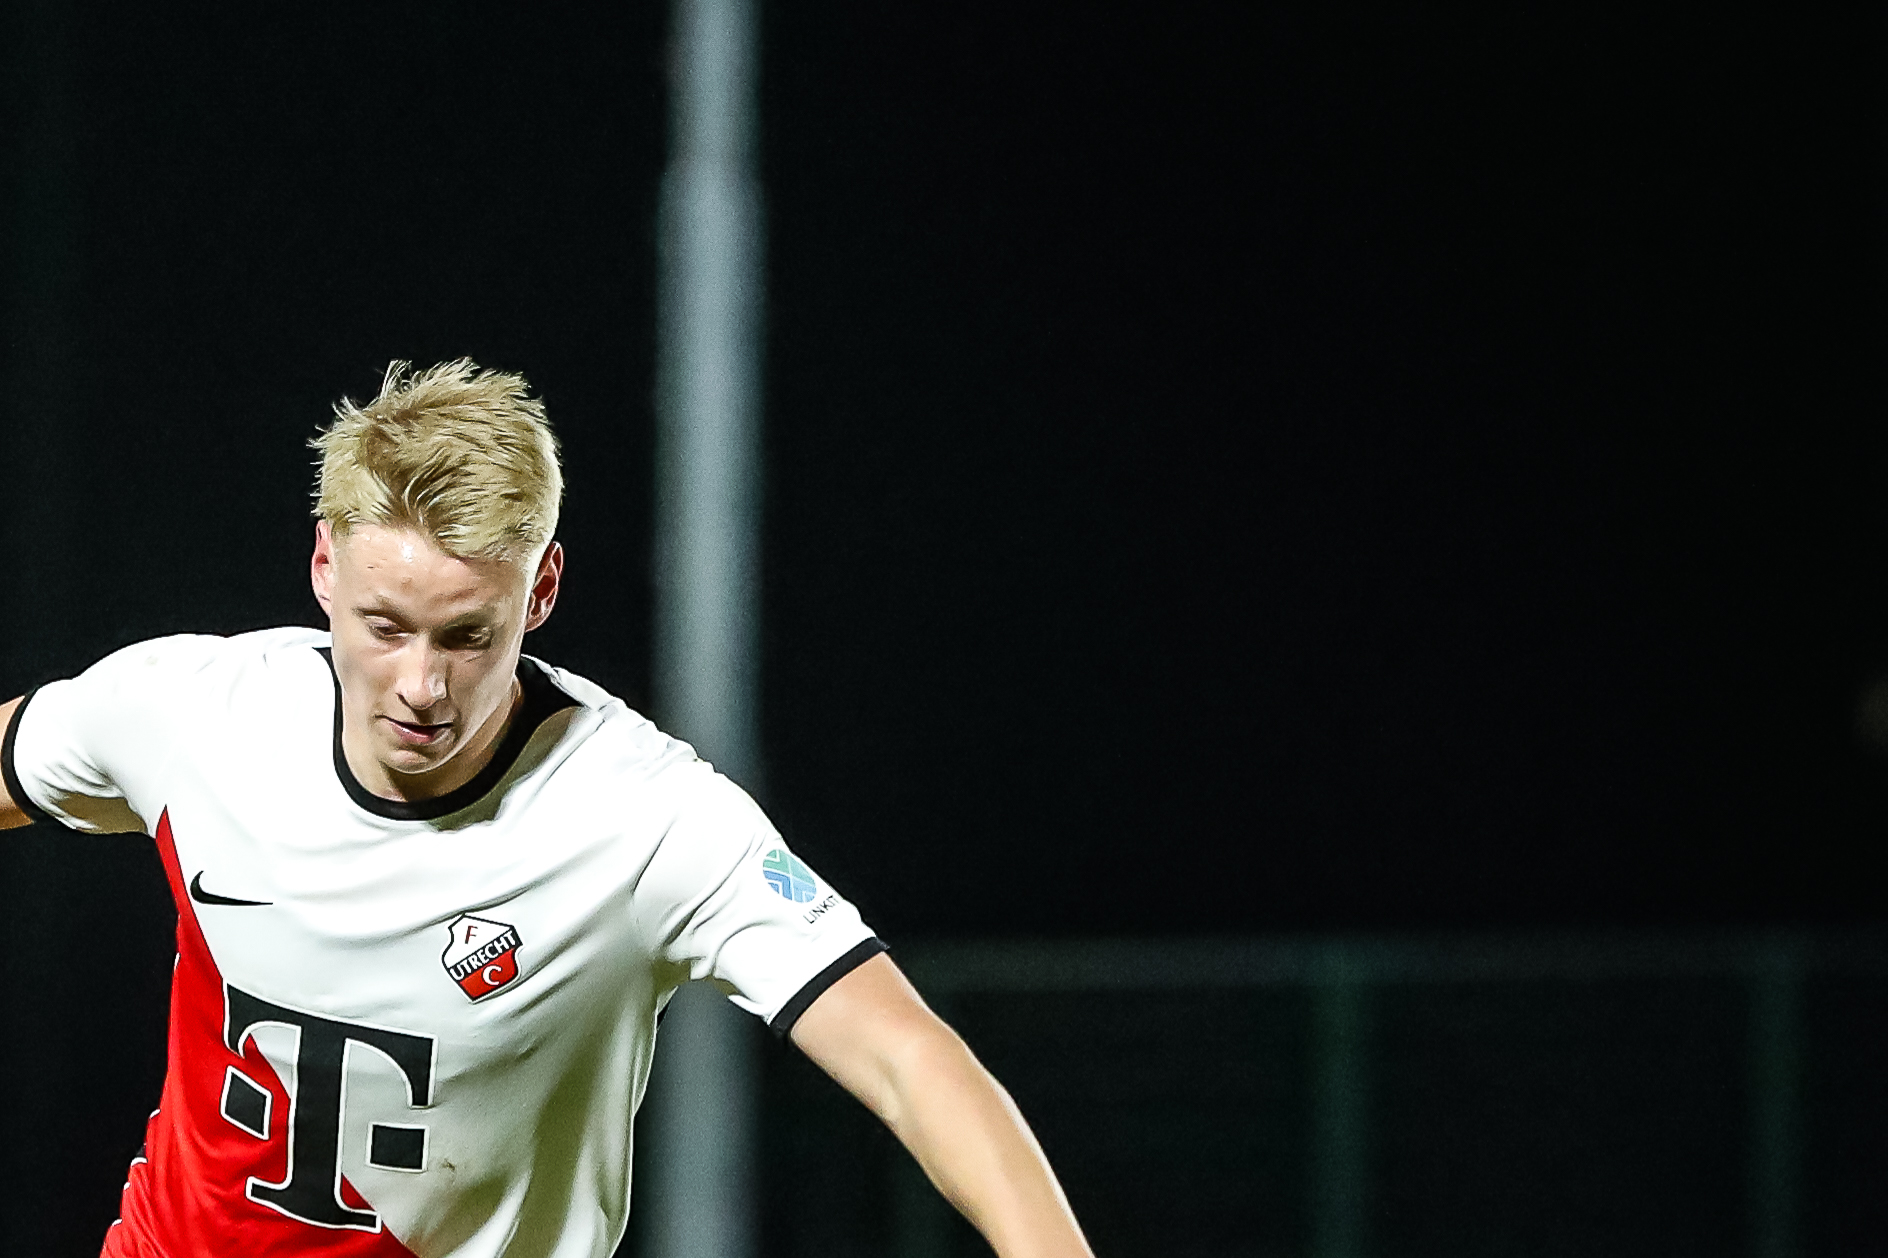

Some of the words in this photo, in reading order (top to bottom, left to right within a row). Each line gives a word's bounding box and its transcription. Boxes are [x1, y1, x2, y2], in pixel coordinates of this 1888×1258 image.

[464, 925, 479, 945] F
[449, 930, 516, 981] UTRECHT
[482, 964, 502, 986] C
[222, 979, 438, 1234] T
